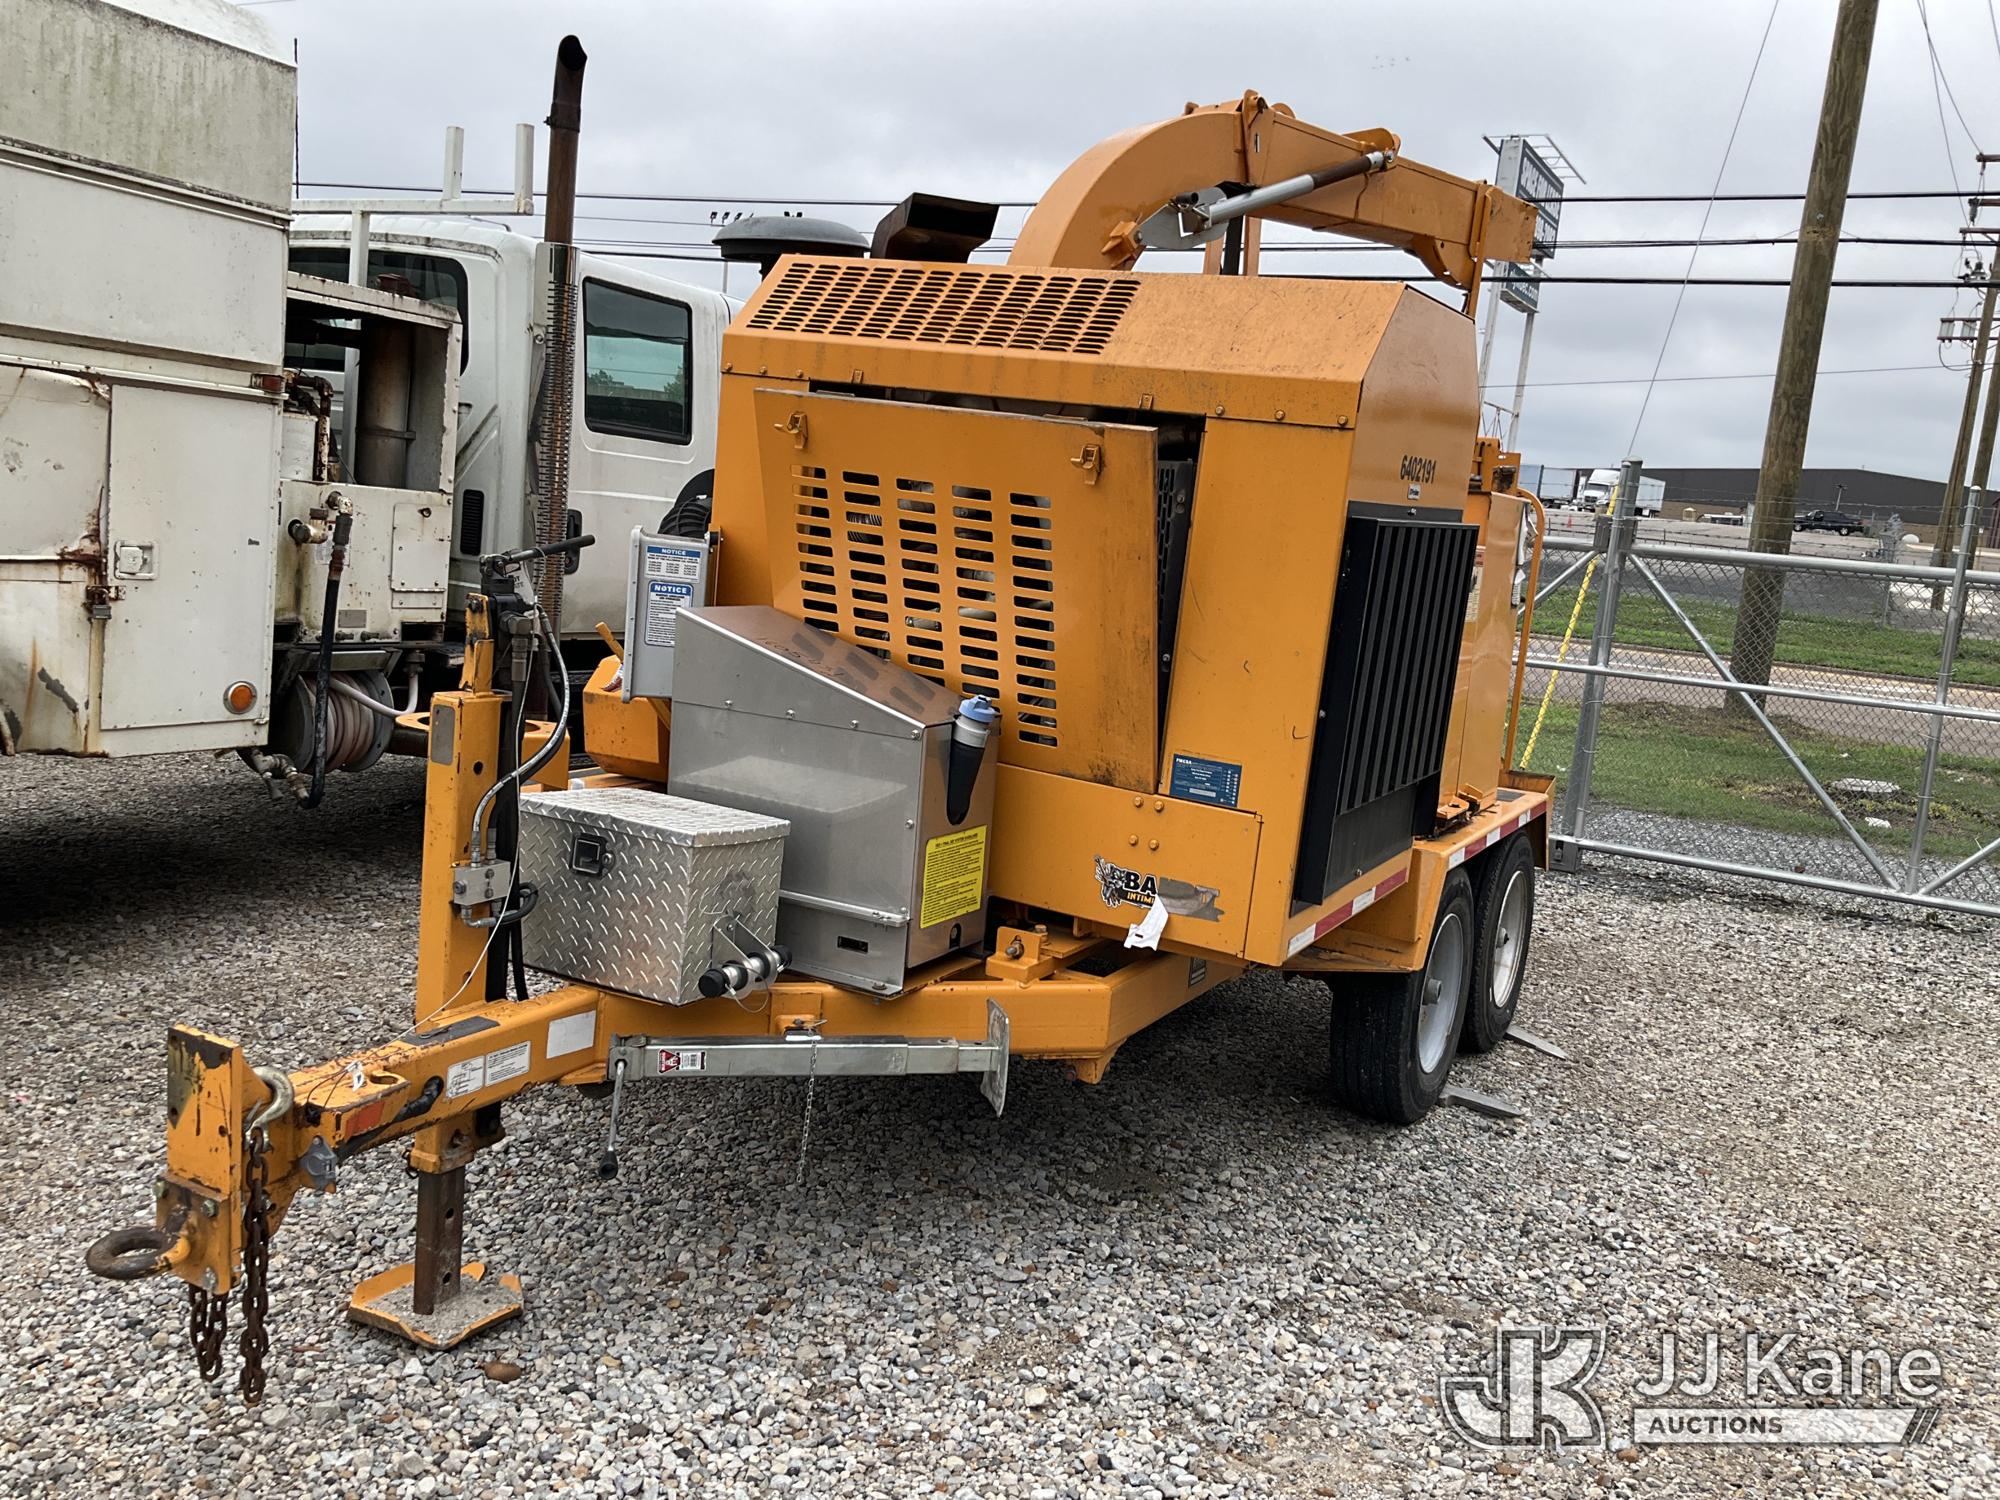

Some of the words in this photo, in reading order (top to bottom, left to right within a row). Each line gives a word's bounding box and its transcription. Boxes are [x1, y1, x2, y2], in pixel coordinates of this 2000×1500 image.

[1400, 454, 1437, 484] 6402191
[661, 548, 687, 556] NOTICE
[654, 585, 687, 594] NOTICE
